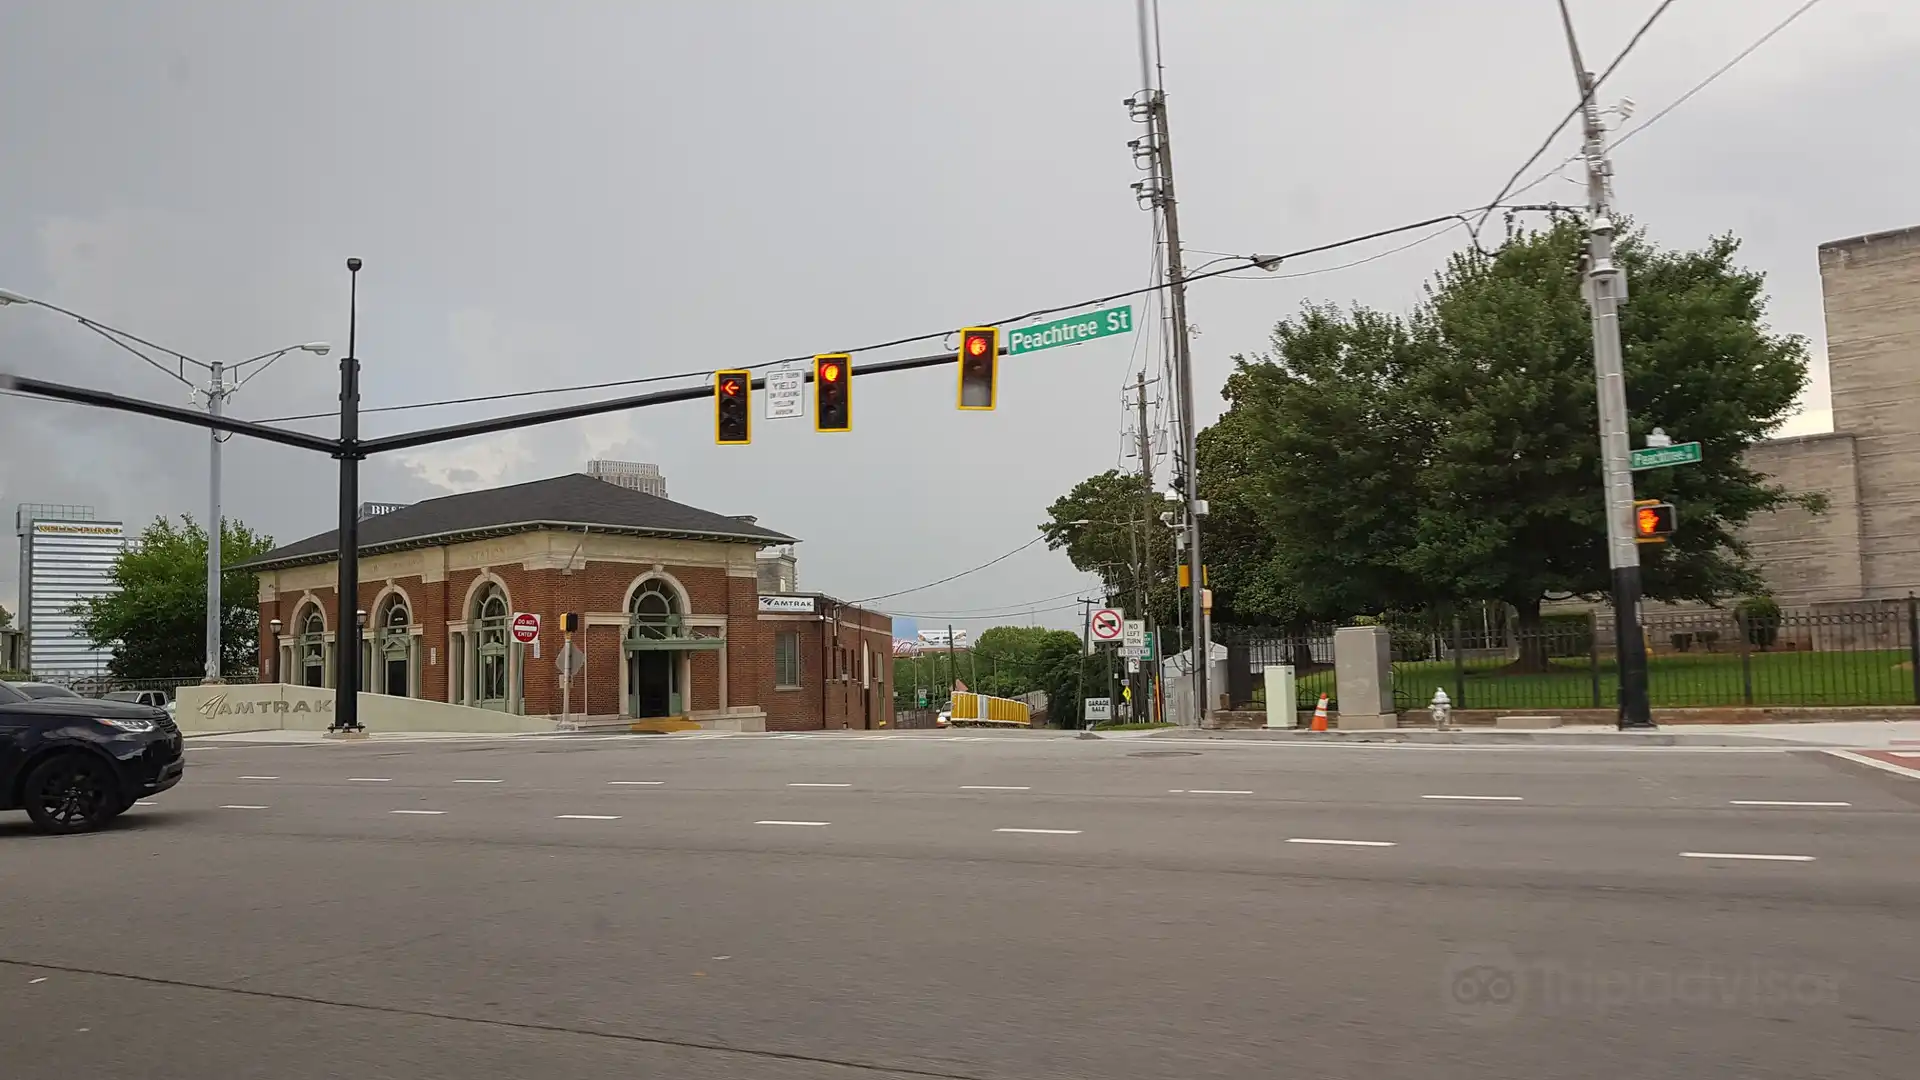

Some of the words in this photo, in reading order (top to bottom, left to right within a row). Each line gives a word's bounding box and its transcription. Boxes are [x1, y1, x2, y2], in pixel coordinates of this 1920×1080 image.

[1010, 320, 1098, 352] Peachtree
[1106, 311, 1128, 331] St
[772, 381, 798, 390] YIELD
[38, 525, 79, 534] WELLS
[80, 526, 120, 535] FARGO
[218, 699, 333, 715] AMTRAK
[1088, 699, 1110, 707] GARAGE
